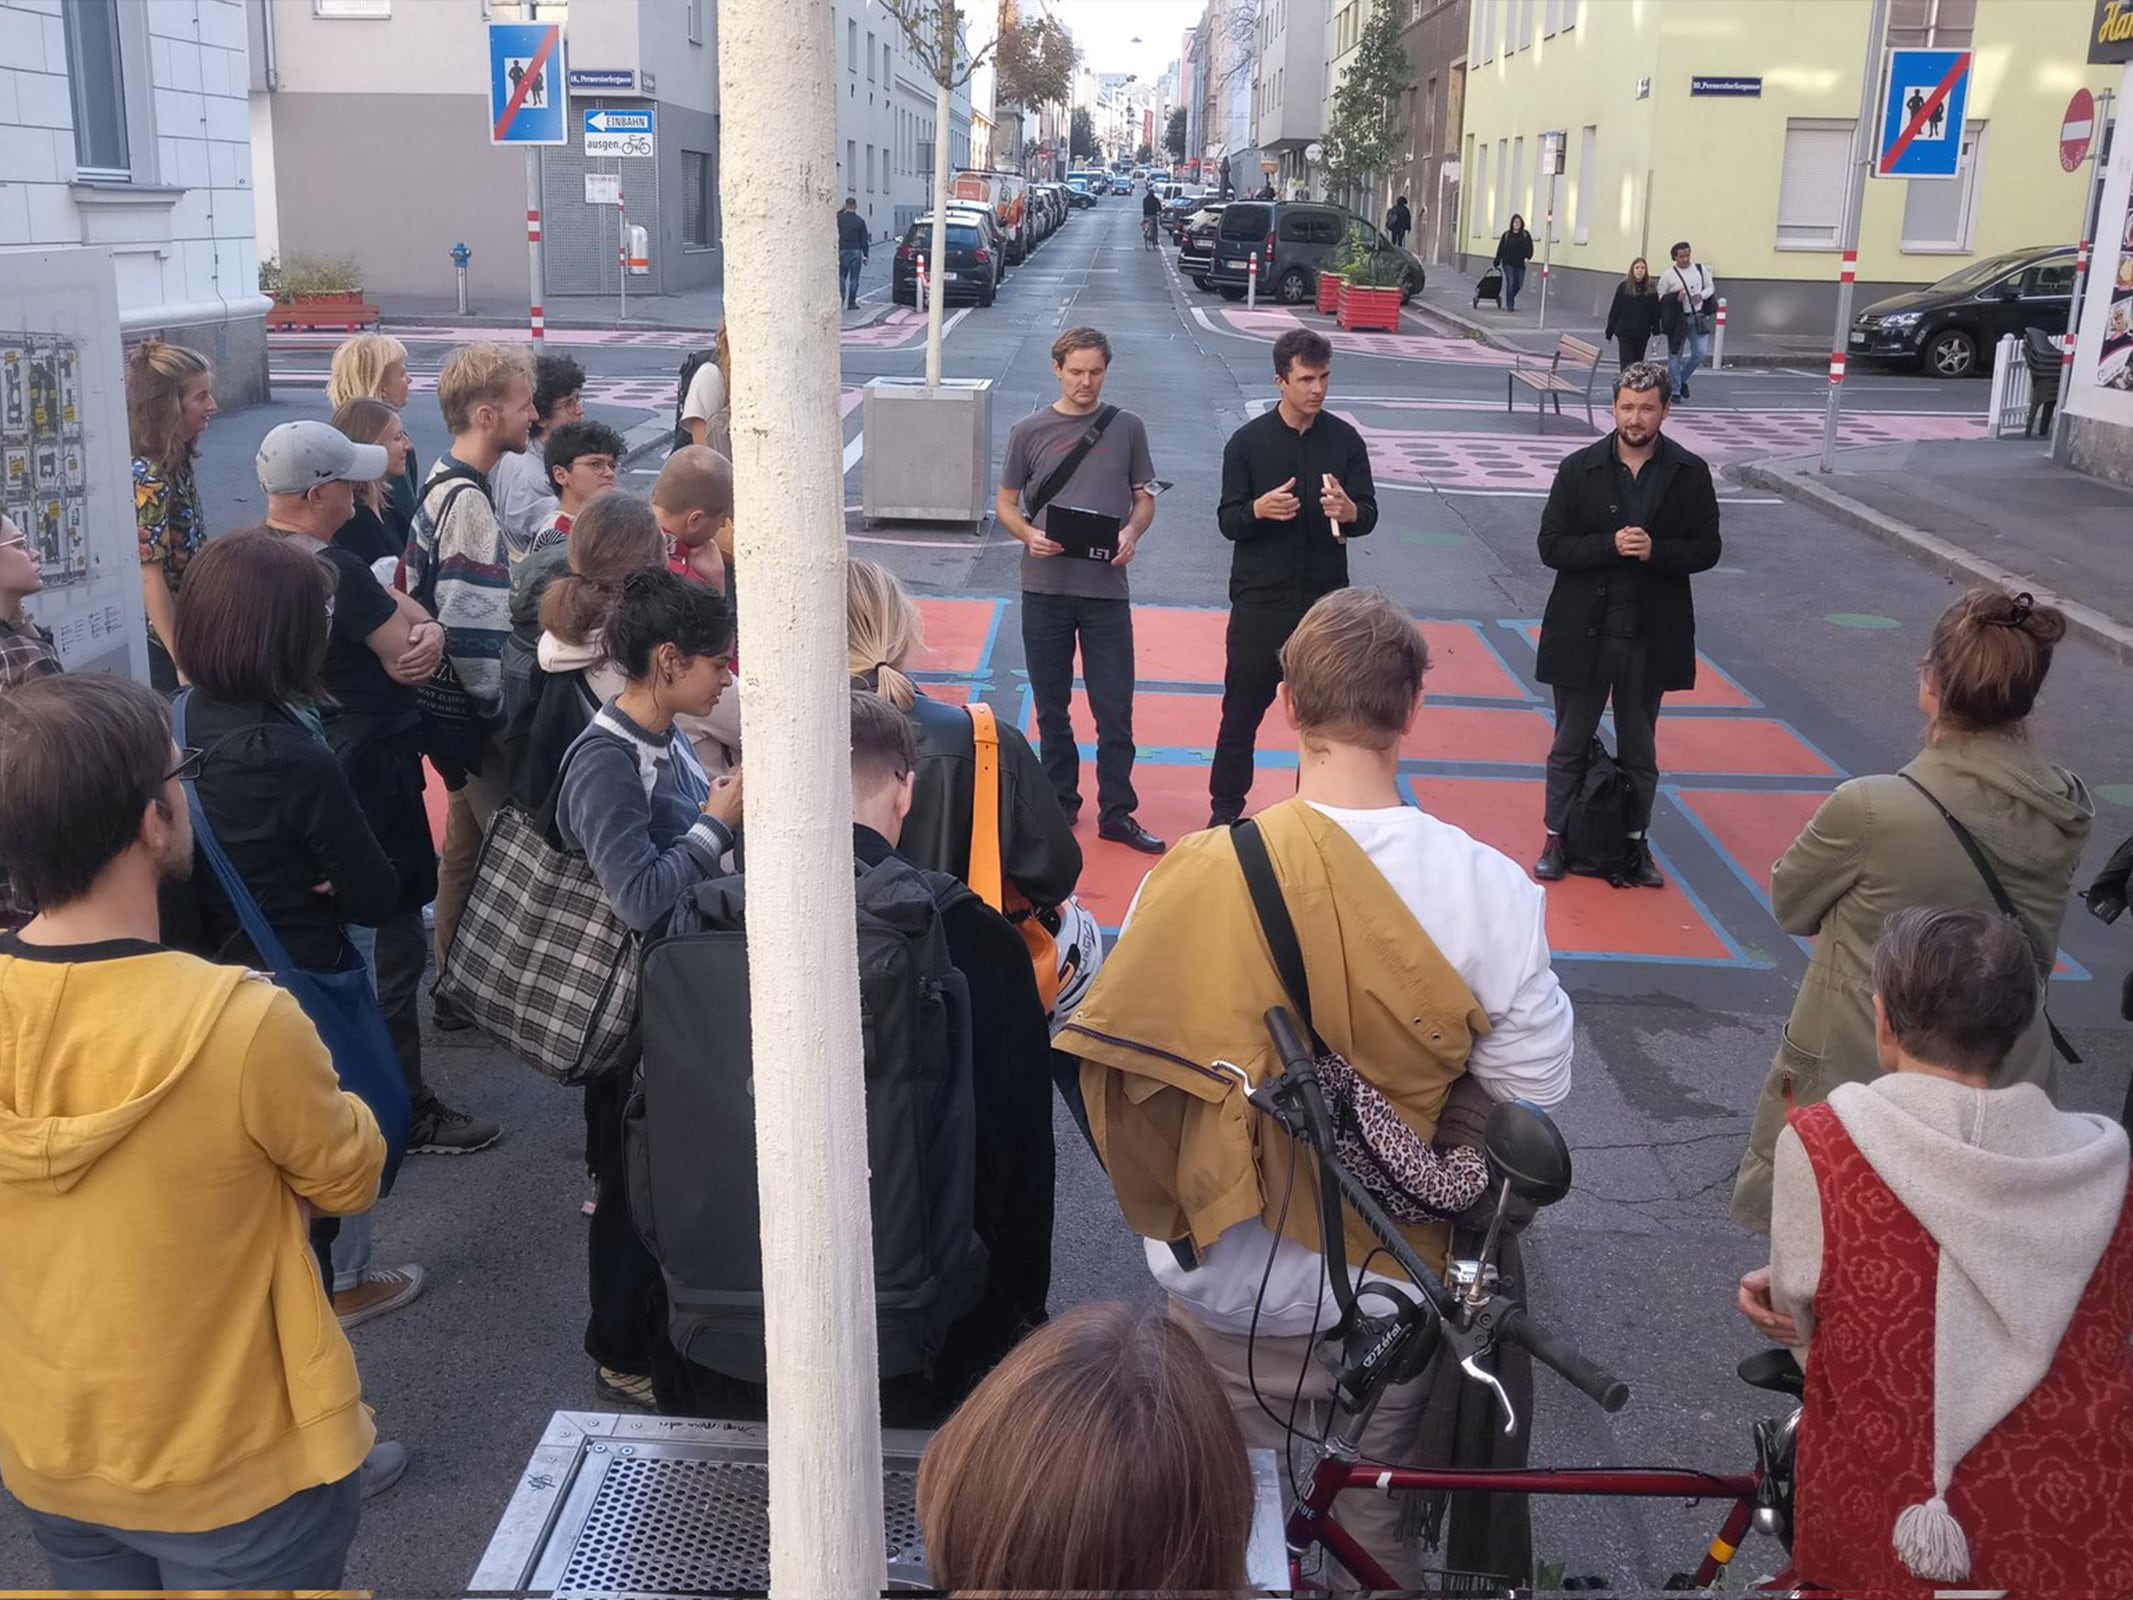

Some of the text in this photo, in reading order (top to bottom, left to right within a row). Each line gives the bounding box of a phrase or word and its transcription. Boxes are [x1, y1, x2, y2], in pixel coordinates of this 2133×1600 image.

[606, 116, 645, 127] EINBAHN
[587, 140, 621, 152] ausgen.
[1374, 1323, 1401, 1357] Zéfal
